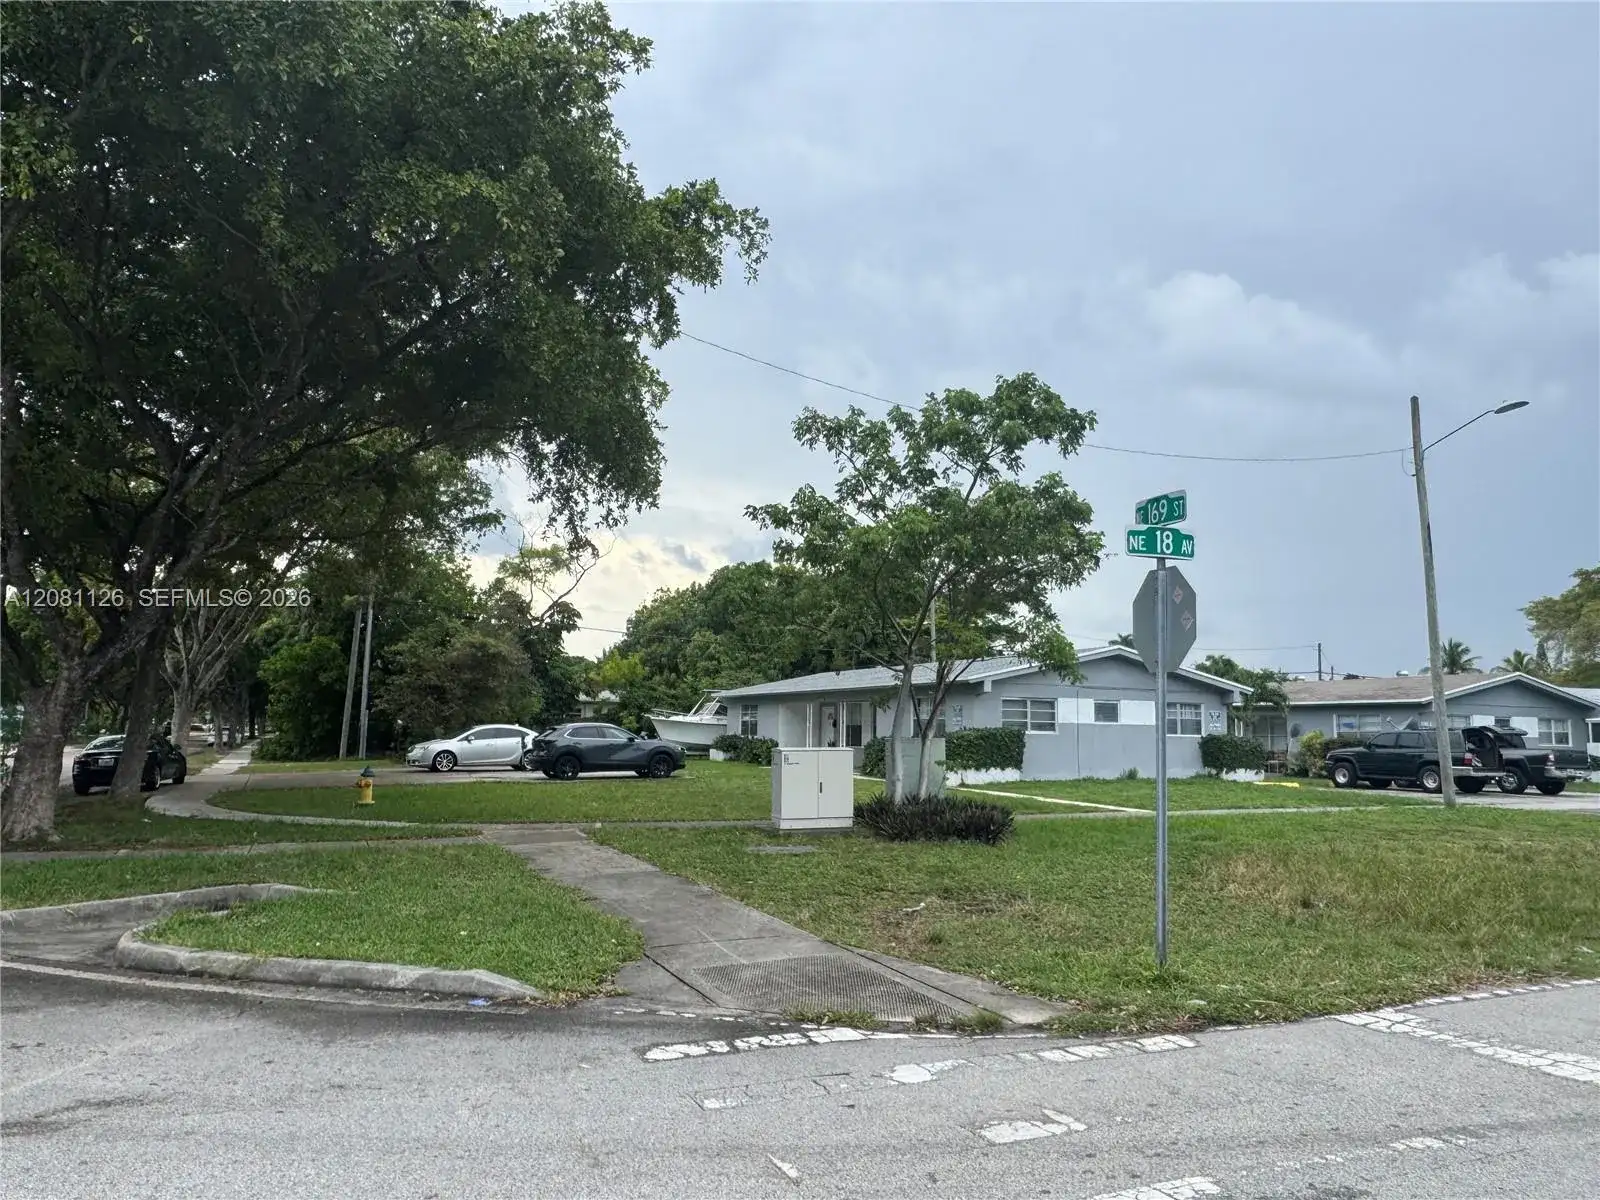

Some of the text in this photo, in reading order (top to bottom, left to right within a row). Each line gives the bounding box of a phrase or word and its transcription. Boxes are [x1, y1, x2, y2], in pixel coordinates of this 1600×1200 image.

[1148, 500, 1167, 525] 169
[1173, 500, 1184, 516] ST
[1129, 530, 1193, 555] NE 18 AV
